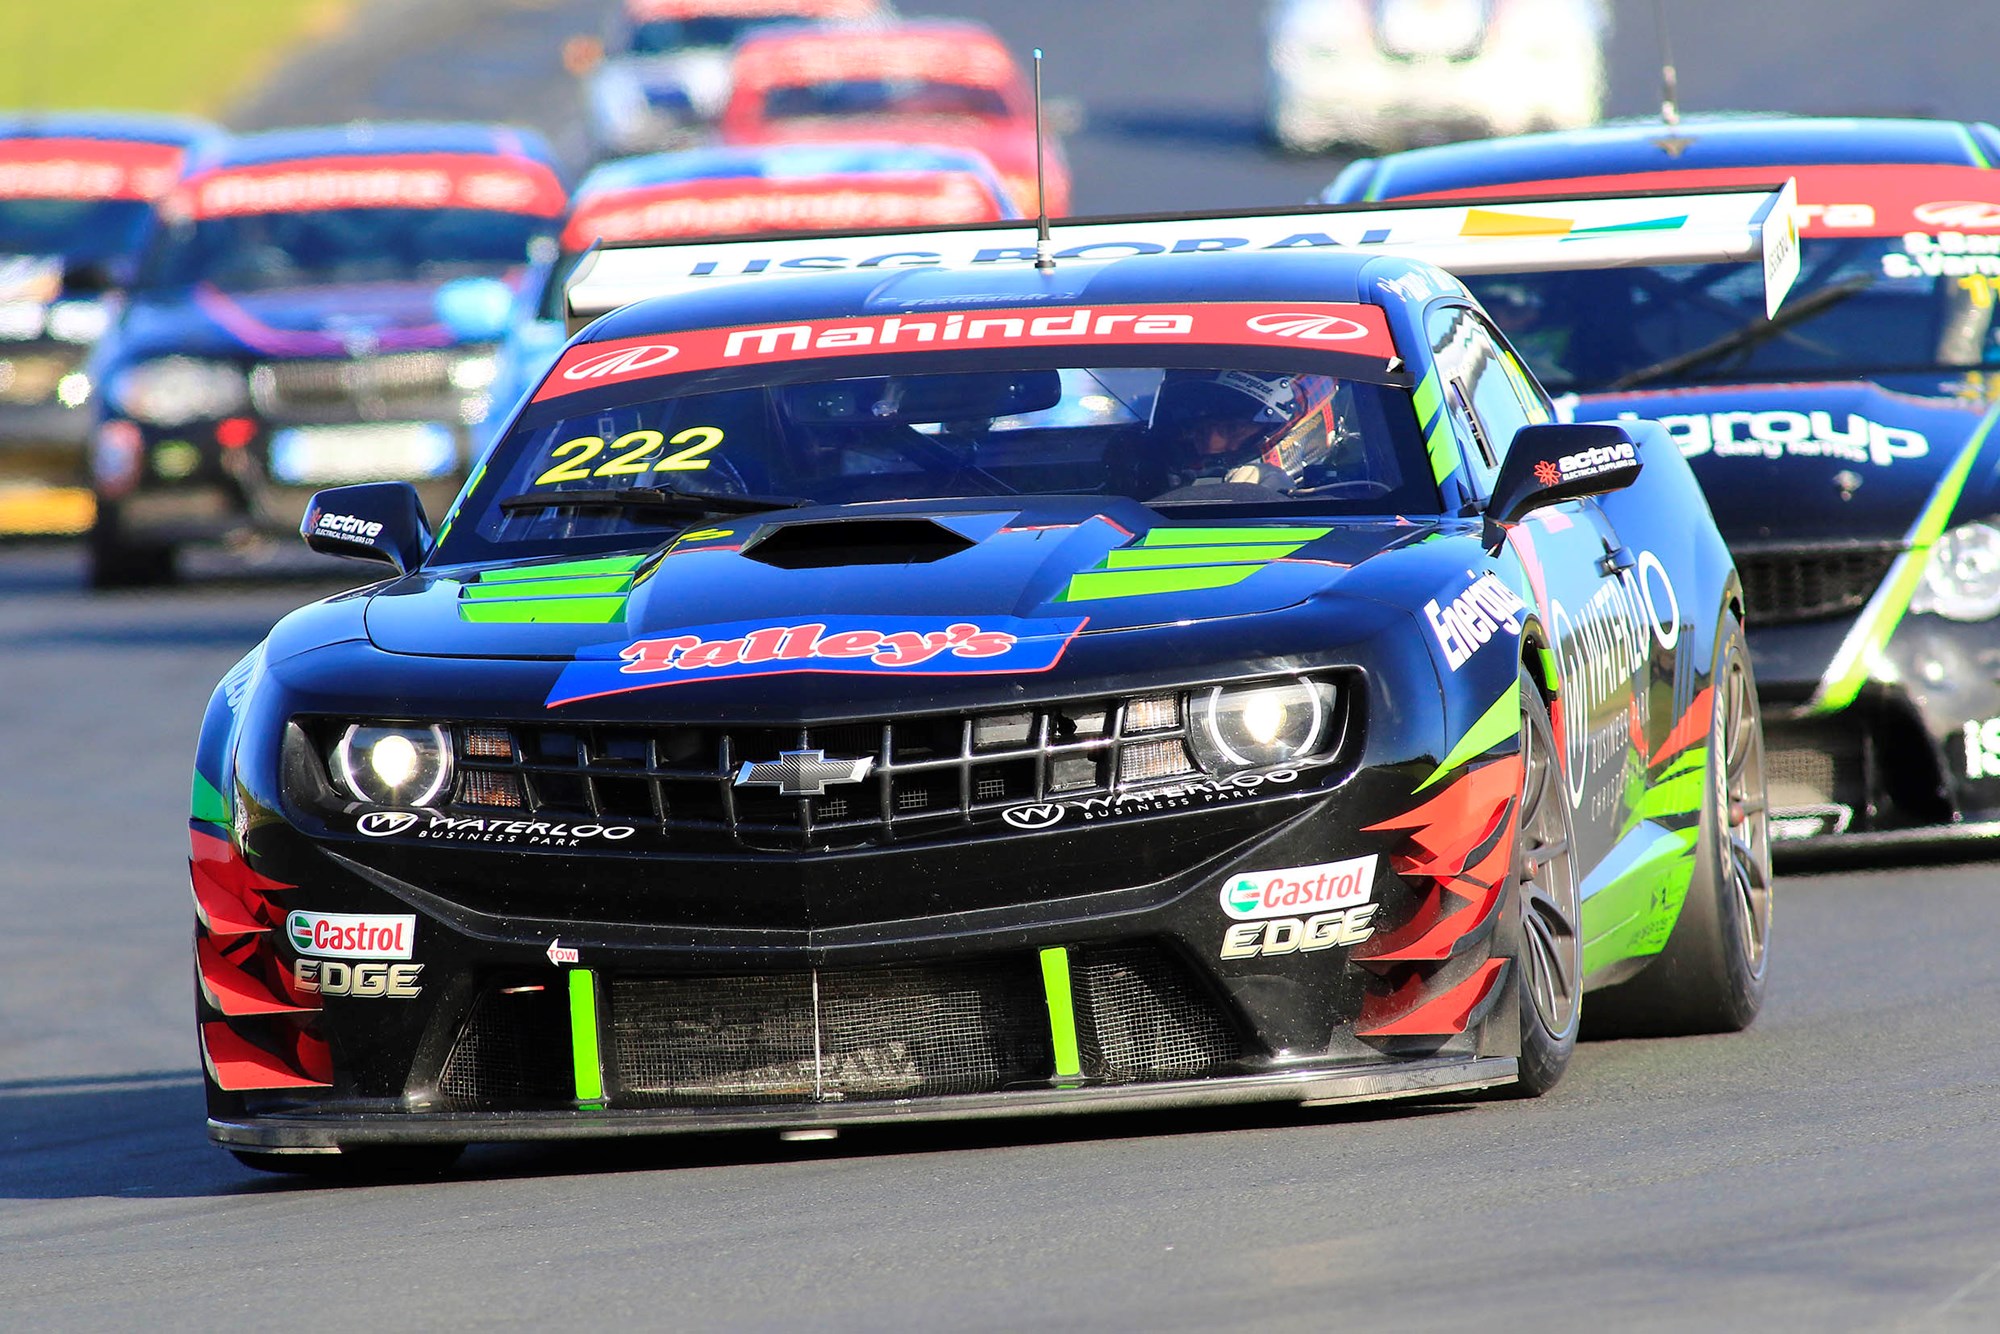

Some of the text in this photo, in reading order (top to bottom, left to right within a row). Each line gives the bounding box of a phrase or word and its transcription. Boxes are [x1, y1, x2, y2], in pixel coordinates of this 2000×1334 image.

[723, 310, 1194, 357] mahindra
[535, 426, 725, 486] 222
[1558, 443, 1635, 472] active
[319, 513, 383, 537] active
[619, 623, 1017, 673] Talley's
[1070, 769, 1298, 811] WATERLOO
[1084, 788, 1258, 820] BUSINESS PARK
[418, 830, 580, 847] BUSINESS PARK
[429, 816, 635, 840] WATERLOO
[1264, 867, 1363, 908] Castrol
[314, 920, 404, 951] Castrol
[1220, 903, 1379, 961] EDGE
[549, 949, 577, 961] TOW
[294, 959, 425, 999] EDGE
